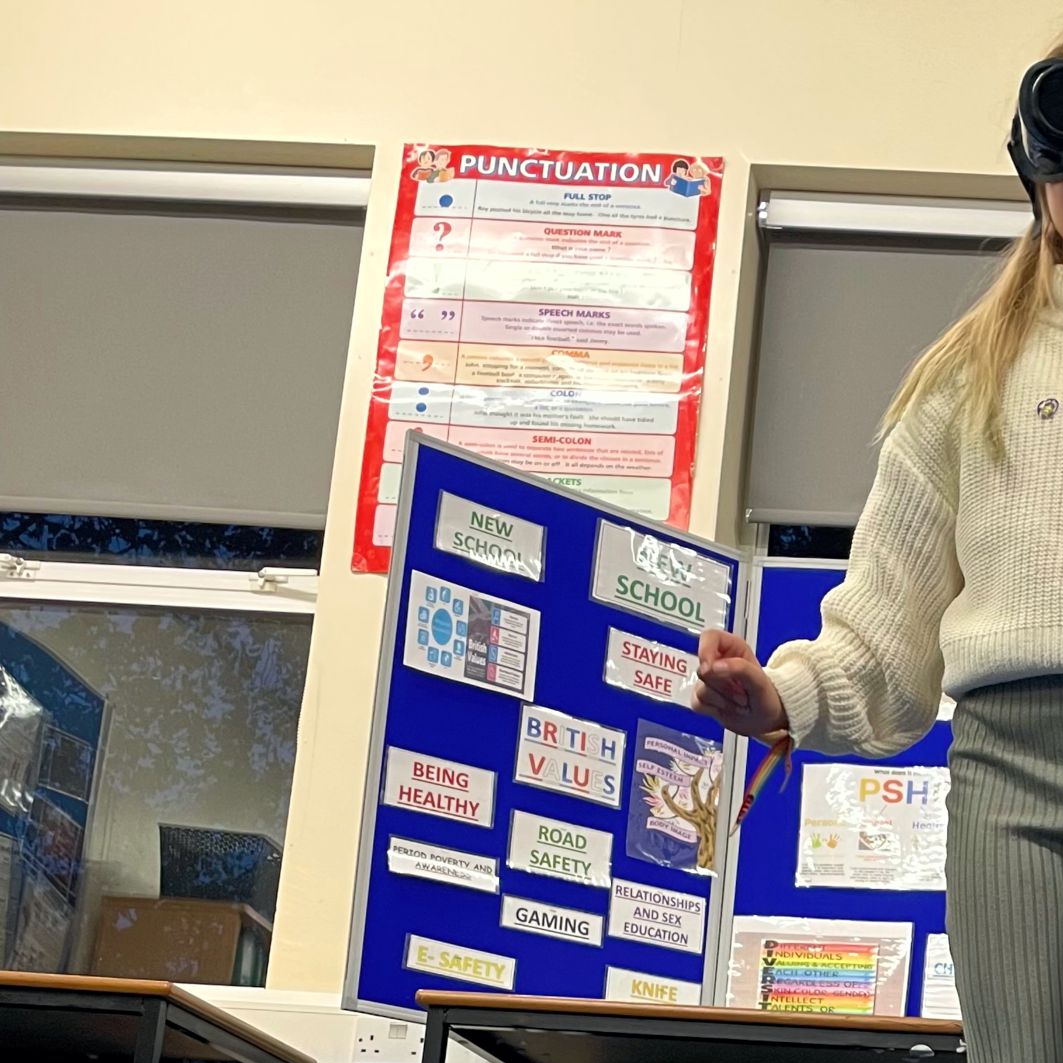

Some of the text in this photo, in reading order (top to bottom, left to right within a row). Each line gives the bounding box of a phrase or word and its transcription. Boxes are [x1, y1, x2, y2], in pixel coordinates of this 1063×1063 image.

[459, 154, 661, 183] PUNCTUATION
[564, 192, 612, 201] FULL STOP
[544, 228, 622, 238] QUESTION MARK
[538, 308, 611, 319] SPEECH MARKS
[532, 435, 591, 445] SEMI-COLON
[470, 511, 514, 538] NEW
[453, 531, 525, 570] SCHOOL
[615, 575, 705, 623] SCHOOL
[621, 640, 688, 674] STAYING
[633, 669, 673, 694] SAFE
[526, 716, 616, 761] BRITISH
[647, 740, 681, 756] PERSONAL
[412, 761, 470, 789] BEING
[528, 752, 616, 795] VALUES
[638, 762, 683, 783] SELF ESTEEM
[398, 785, 480, 818] HEALTHY
[859, 778, 935, 804] PSH
[538, 824, 587, 850] ROAD
[649, 821, 692, 839] BODY IMAGE
[393, 845, 492, 874] PERIOD POVERTY AND
[529, 849, 592, 877] SAFETY
[615, 884, 701, 912] RELATIONSHIPS
[515, 907, 590, 936] GAMING
[633, 906, 682, 926] AND SEX
[623, 922, 689, 945] EDUCATION
[439, 949, 506, 980] SAFETY
[766, 950, 843, 960] INDIVIDUALS
[762, 967, 839, 977] EACH OTHER
[631, 978, 678, 1001] KNIFE
[762, 994, 822, 1004] INTELLECT
[759, 1002, 814, 1012] TALENTS
